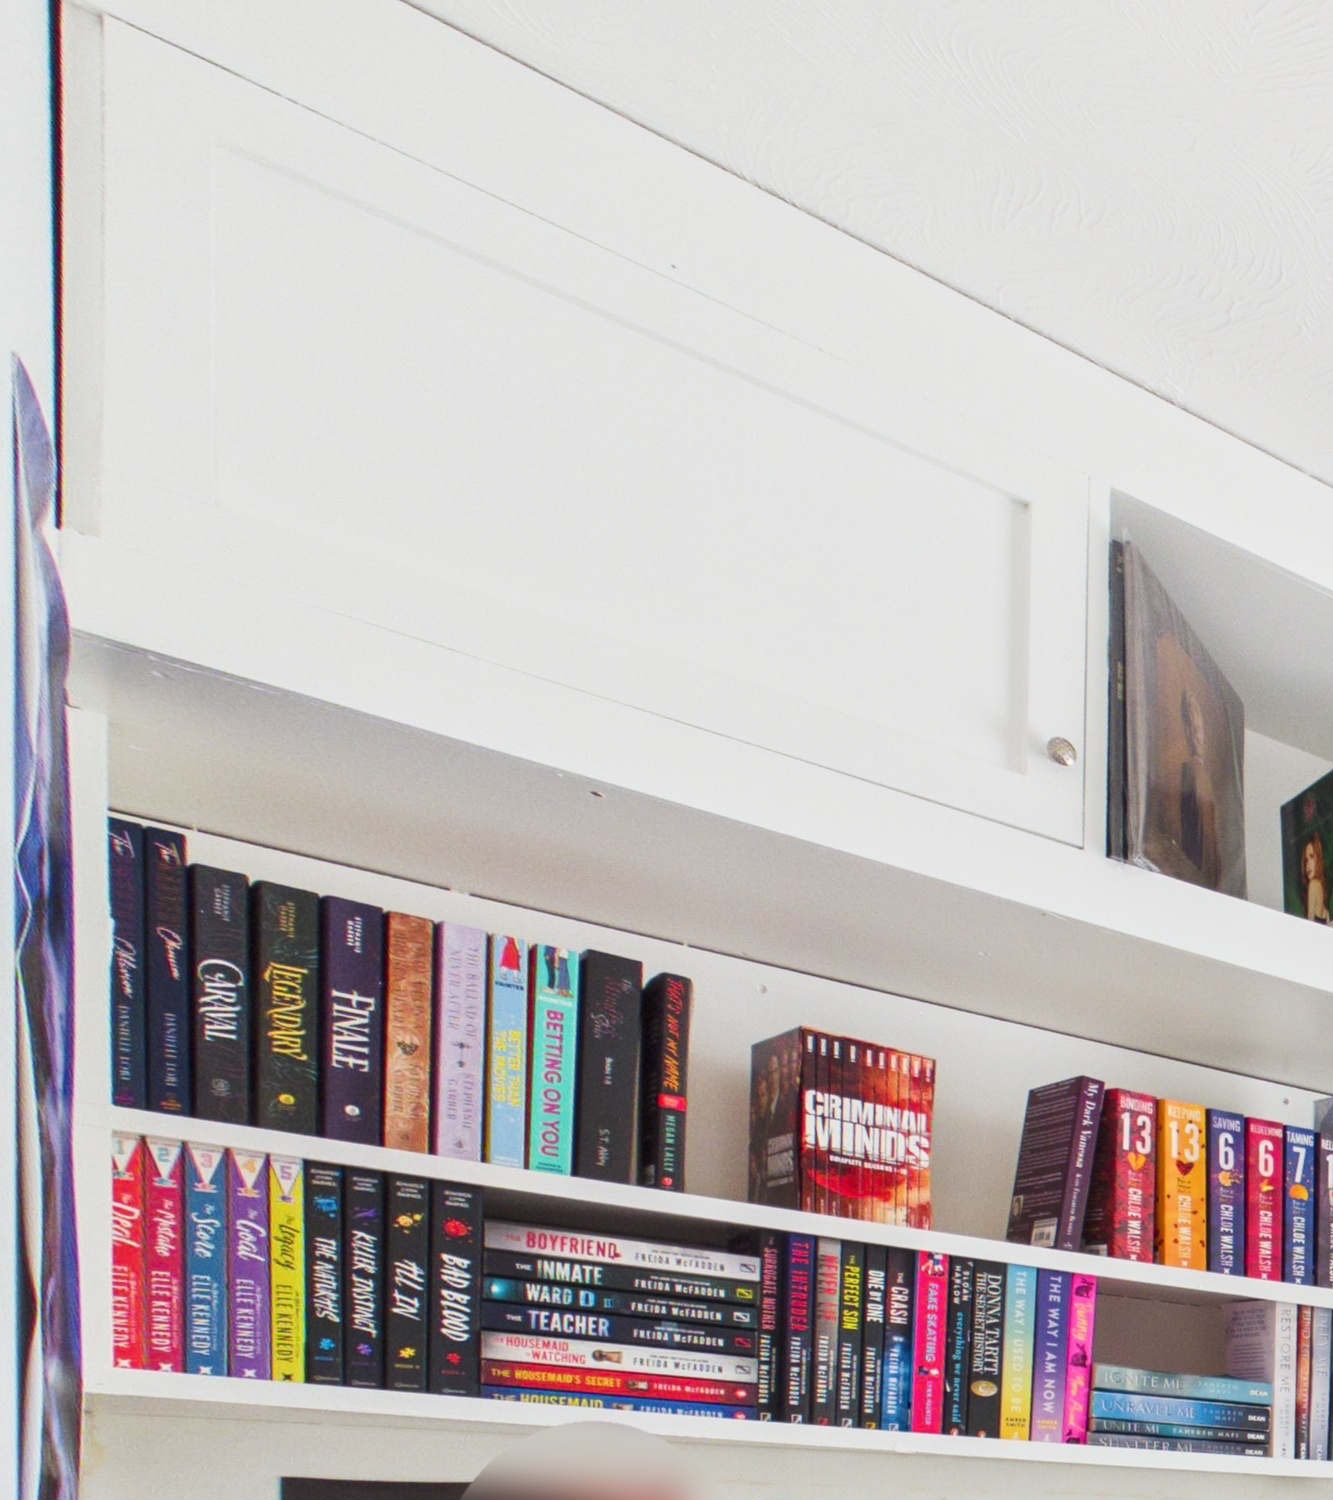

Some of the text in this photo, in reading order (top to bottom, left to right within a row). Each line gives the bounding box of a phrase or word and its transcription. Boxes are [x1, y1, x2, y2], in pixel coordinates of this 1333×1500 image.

[198, 958, 244, 1041] CARAVAL
[264, 962, 308, 1060] LEGENDARY
[331, 990, 375, 1072] FINALE
[663, 978, 685, 1092] THAT'S NOT MY NAME
[540, 1009, 564, 1158] BETTING ON YOU
[804, 1089, 928, 1135] CRIMINAL
[1120, 1096, 1154, 1114] BINDING
[1212, 1116, 1241, 1133] SAVING
[663, 1114, 676, 1173] MEGAN LALLY
[804, 1114, 930, 1170] MINDS
[1075, 1082, 1099, 1169] My Dark Vanessa
[1120, 1112, 1151, 1155] 13
[1286, 1130, 1314, 1147] TAMING
[1218, 1132, 1235, 1170] 6
[1292, 1146, 1307, 1183] 7
[113, 1202, 141, 1248] Deal
[1127, 1187, 1143, 1253] CHLOE WALSH
[235, 1219, 267, 1263] Goal
[526, 1231, 617, 1260] BOYFRIEND
[312, 1237, 340, 1324] THE NATURALS
[536, 1259, 603, 1286] INMATE
[635, 1252, 726, 1272] FREIDA McFADDEN
[868, 1270, 885, 1291] ONE
[351, 1229, 378, 1339] KILLER INSTINCT
[391, 1259, 426, 1322] ALL IN
[438, 1252, 472, 1342] BAD BLOOD
[525, 1283, 596, 1307] WARD D
[761, 1247, 778, 1331] SURROGATE MOTHER
[790, 1241, 809, 1333] THE INTRUDER
[842, 1265, 860, 1331] PERFECT SON
[1015, 1271, 1027, 1296] THE
[1049, 1276, 1062, 1303] THE
[275, 1284, 292, 1364] ELLE KENNEDY
[527, 1310, 610, 1338] TEACHER
[866, 1304, 884, 1324] ONE
[890, 1286, 909, 1325] CRASH
[924, 1281, 938, 1363] FAKE SKATING
[972, 1272, 987, 1374] THE SECRET HISTORY
[983, 1273, 1002, 1375] DONNA TARTT
[1013, 1299, 1025, 1326] WAY
[1047, 1308, 1060, 1337] WAY
[505, 1336, 570, 1351] HOUSEMAID
[531, 1350, 587, 1365] WATCHING
[1012, 1339, 1024, 1371] USED
[1044, 1351, 1056, 1374] AM
[1279, 1308, 1292, 1393] RESTORE ME
[491, 1368, 622, 1388] THE HOUSEMAID'S SECRET
[1011, 1374, 1023, 1392] TO
[1042, 1379, 1056, 1414] NOW
[1104, 1371, 1158, 1388] IGNITE
[1101, 1399, 1195, 1419] UNRAVEL ME
